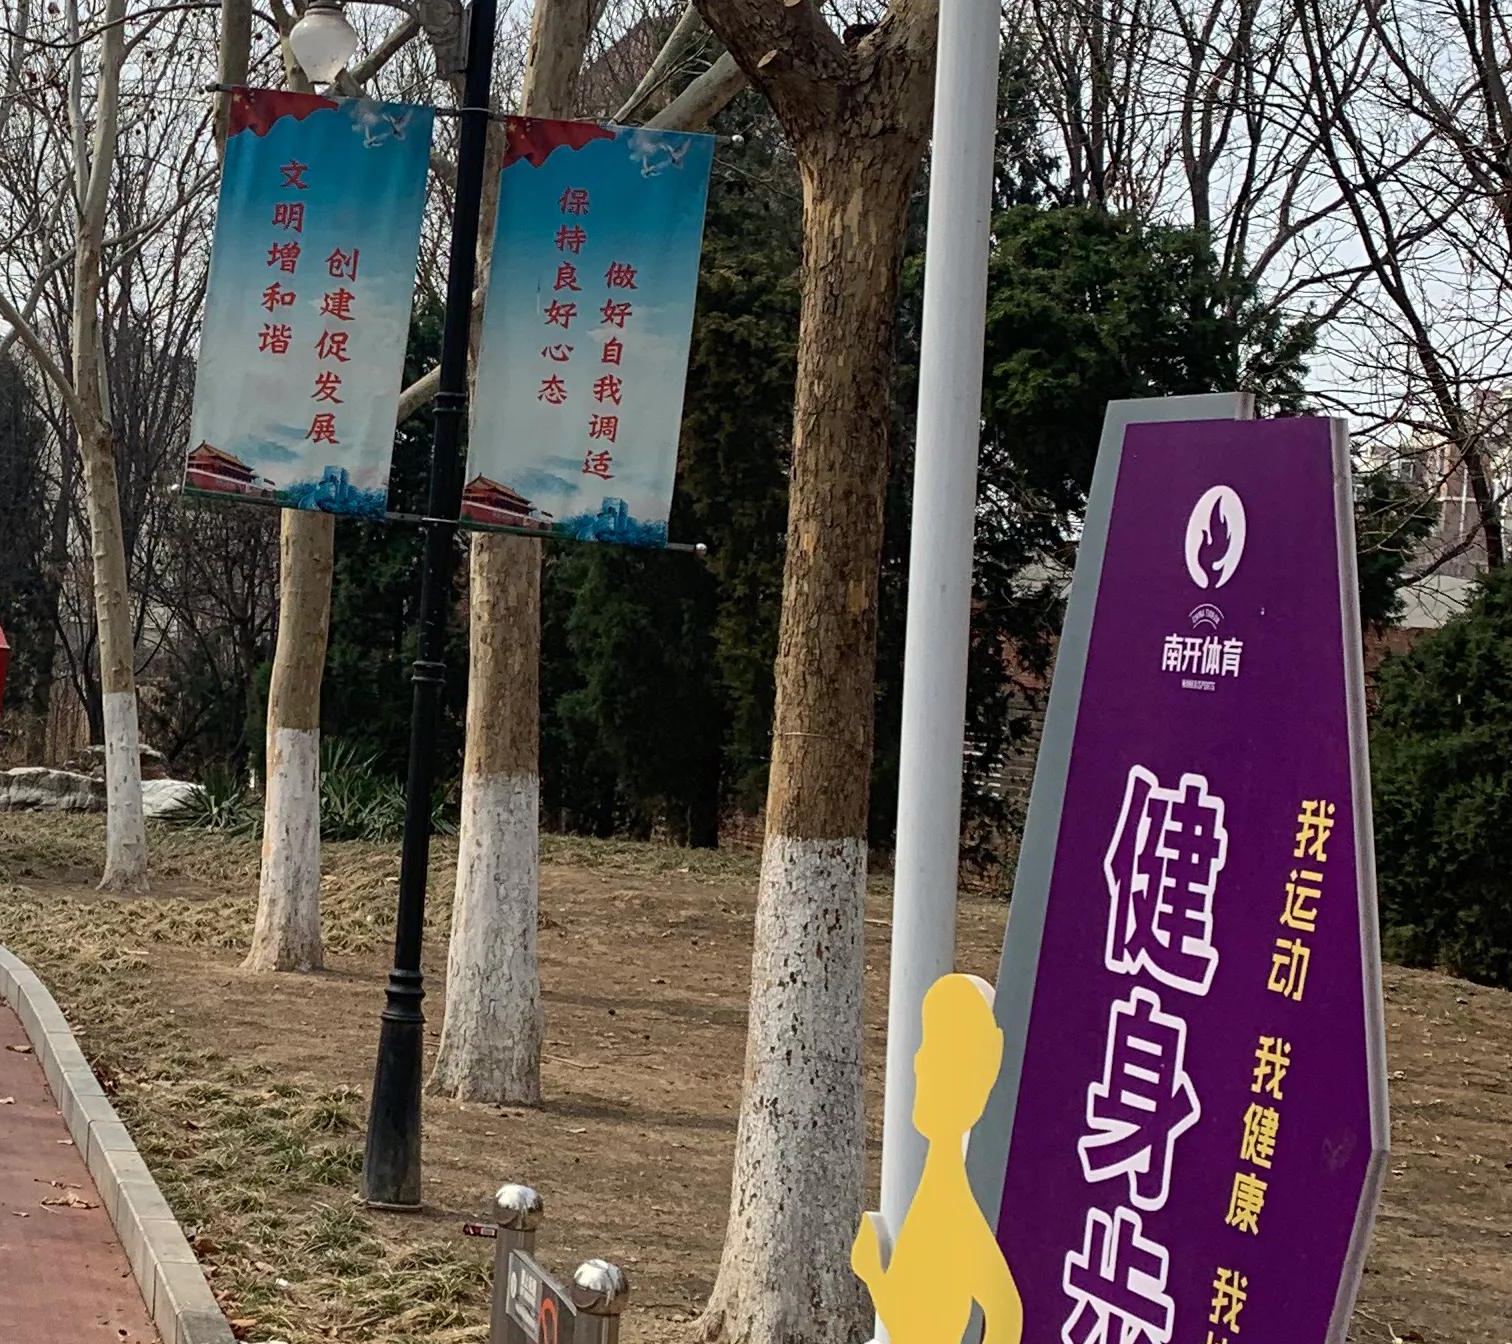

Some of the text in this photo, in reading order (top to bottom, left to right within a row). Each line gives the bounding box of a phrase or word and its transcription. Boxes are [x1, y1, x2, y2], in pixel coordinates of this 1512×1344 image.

[257, 159, 309, 355] 文明增和谐
[305, 247, 361, 445] 创建促发展
[536, 185, 590, 406] 保持良好心态
[580, 261, 638, 481] 做好自我调适
[1161, 632, 1244, 678] 南开体育
[1267, 798, 1336, 1002] 我运动
[1224, 1035, 1292, 1236] 我健康
